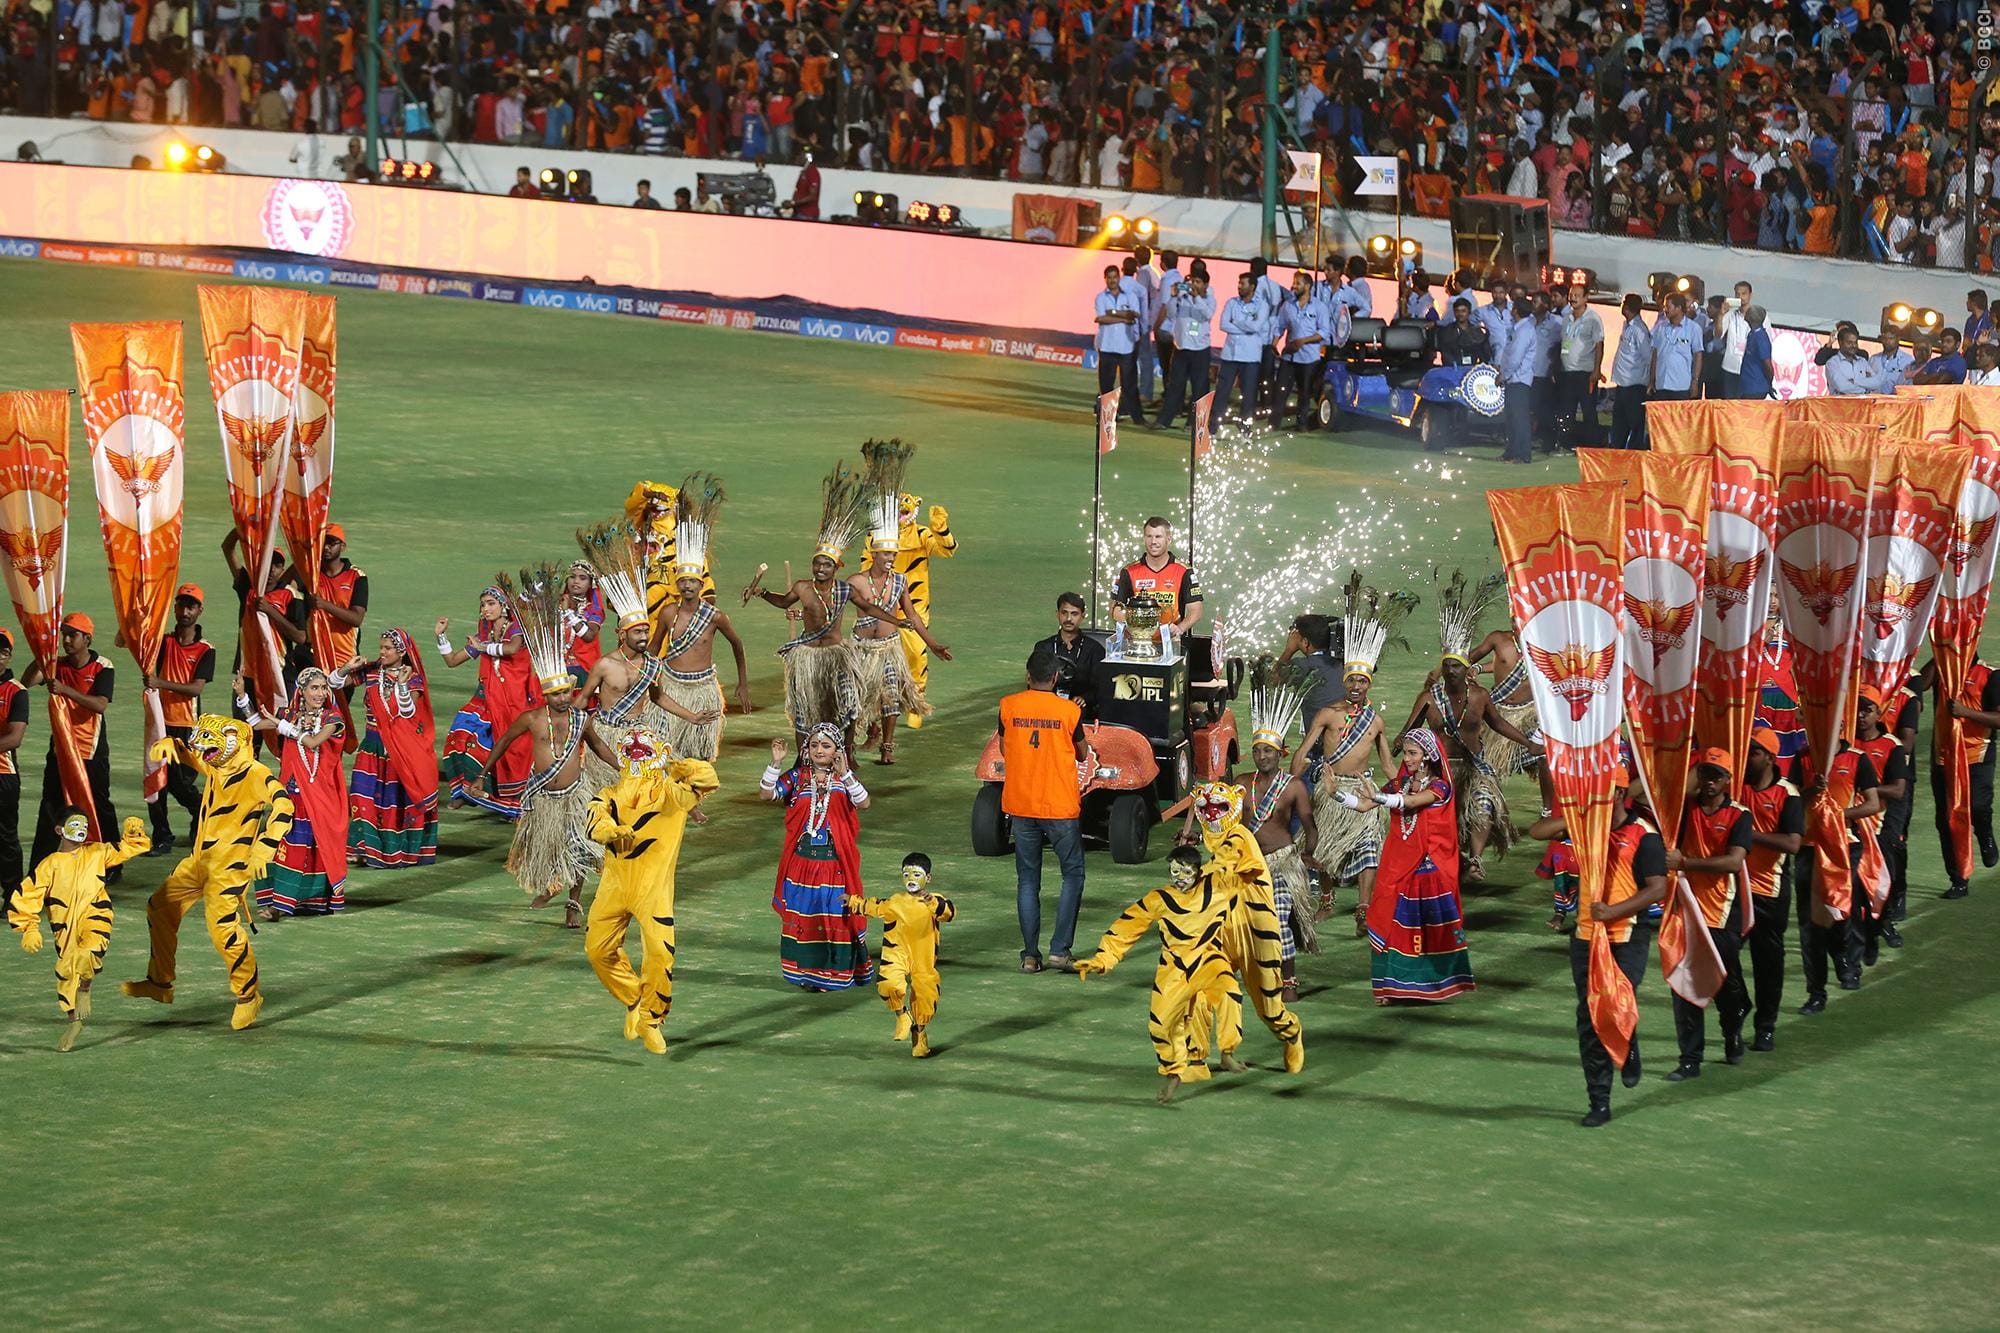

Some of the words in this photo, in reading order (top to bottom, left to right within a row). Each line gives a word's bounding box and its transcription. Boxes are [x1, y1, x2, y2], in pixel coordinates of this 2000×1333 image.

[617, 297, 634, 313] YES
[637, 300, 660, 315] BANK
[659, 306, 707, 322] BREZZA
[990, 338, 1008, 353] YES
[1009, 340, 1036, 357] BANK
[1034, 350, 1083, 365] BREZZA
[1142, 687, 1164, 702] IPL
[1029, 730, 1039, 749] 4
